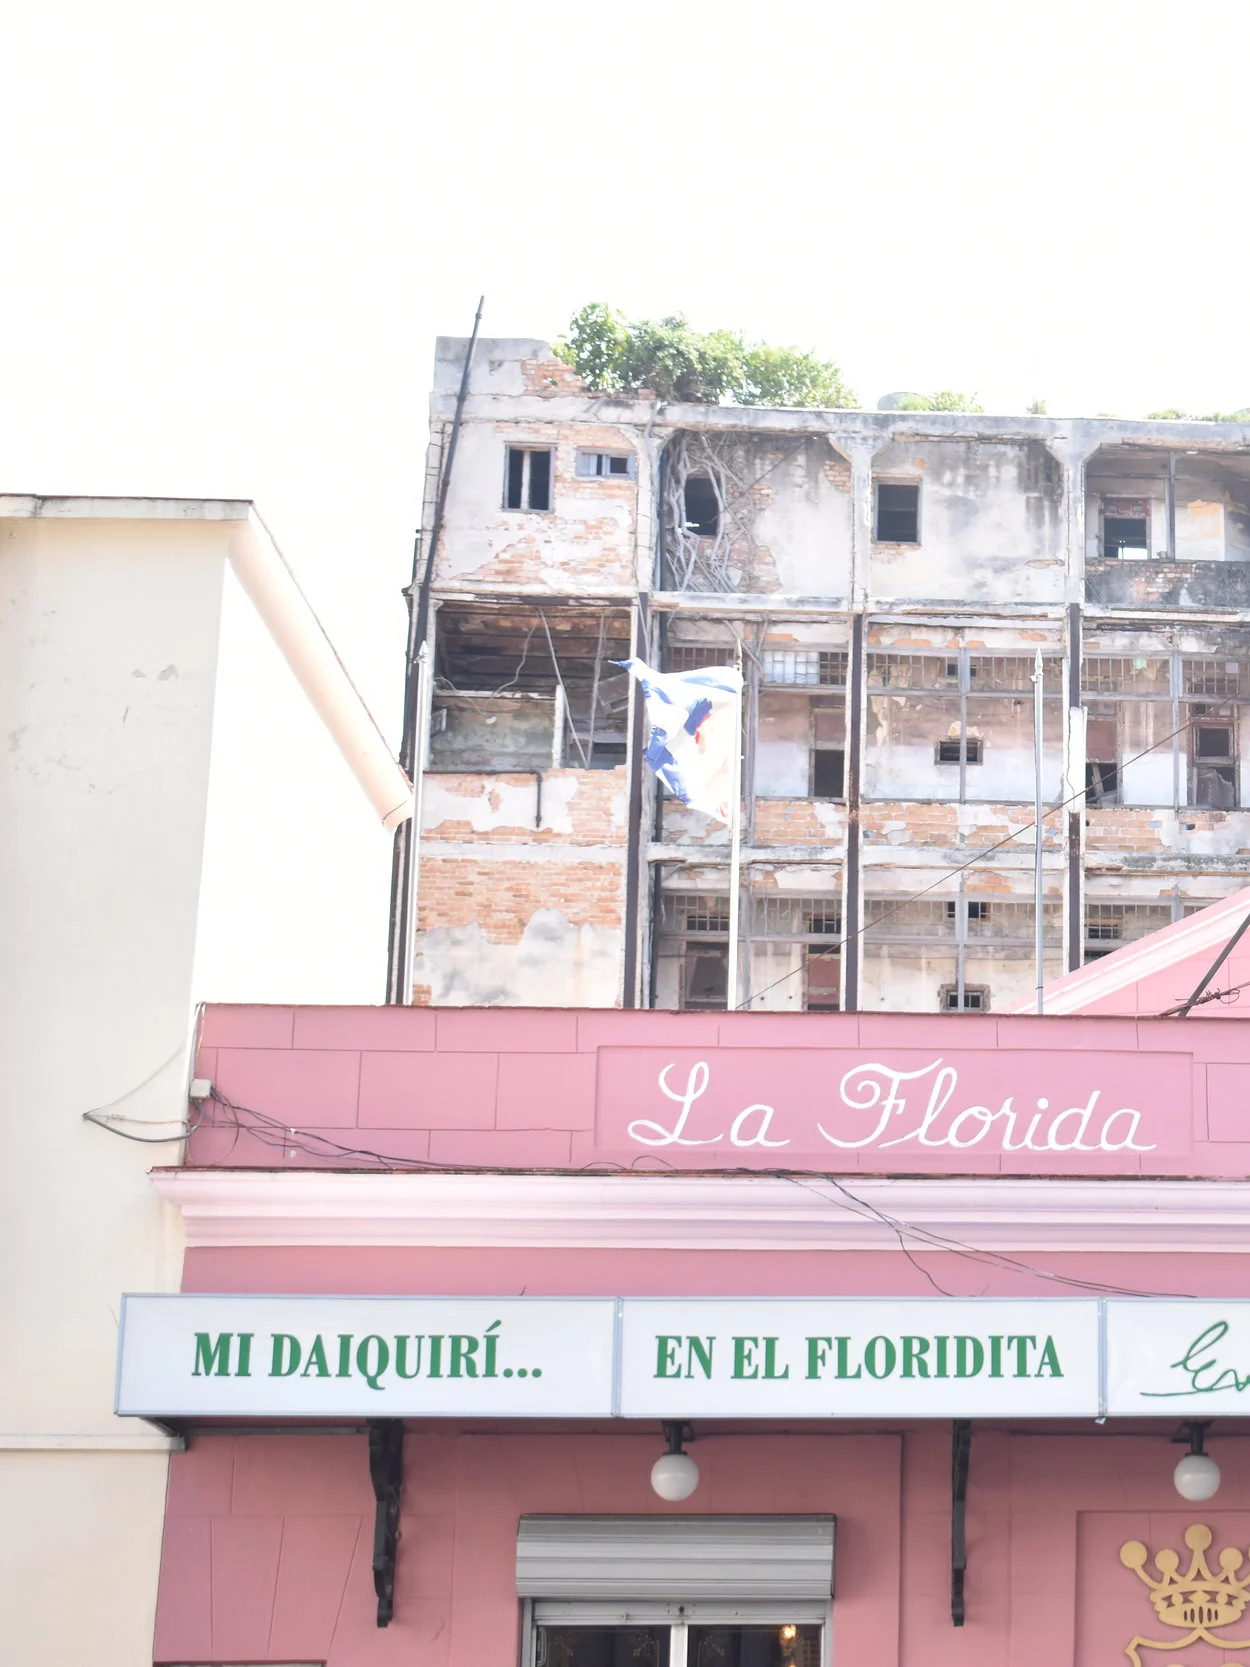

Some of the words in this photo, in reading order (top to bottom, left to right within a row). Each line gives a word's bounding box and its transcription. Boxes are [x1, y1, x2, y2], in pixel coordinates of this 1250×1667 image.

[627, 1061, 791, 1147] La
[817, 1058, 1157, 1151] Florida
[191, 1332, 255, 1378] MI
[268, 1320, 543, 1391] DAIQUIRÍ...
[653, 1335, 716, 1379] EN
[730, 1336, 789, 1380] EL
[804, 1334, 1064, 1379] FLORIDITA
